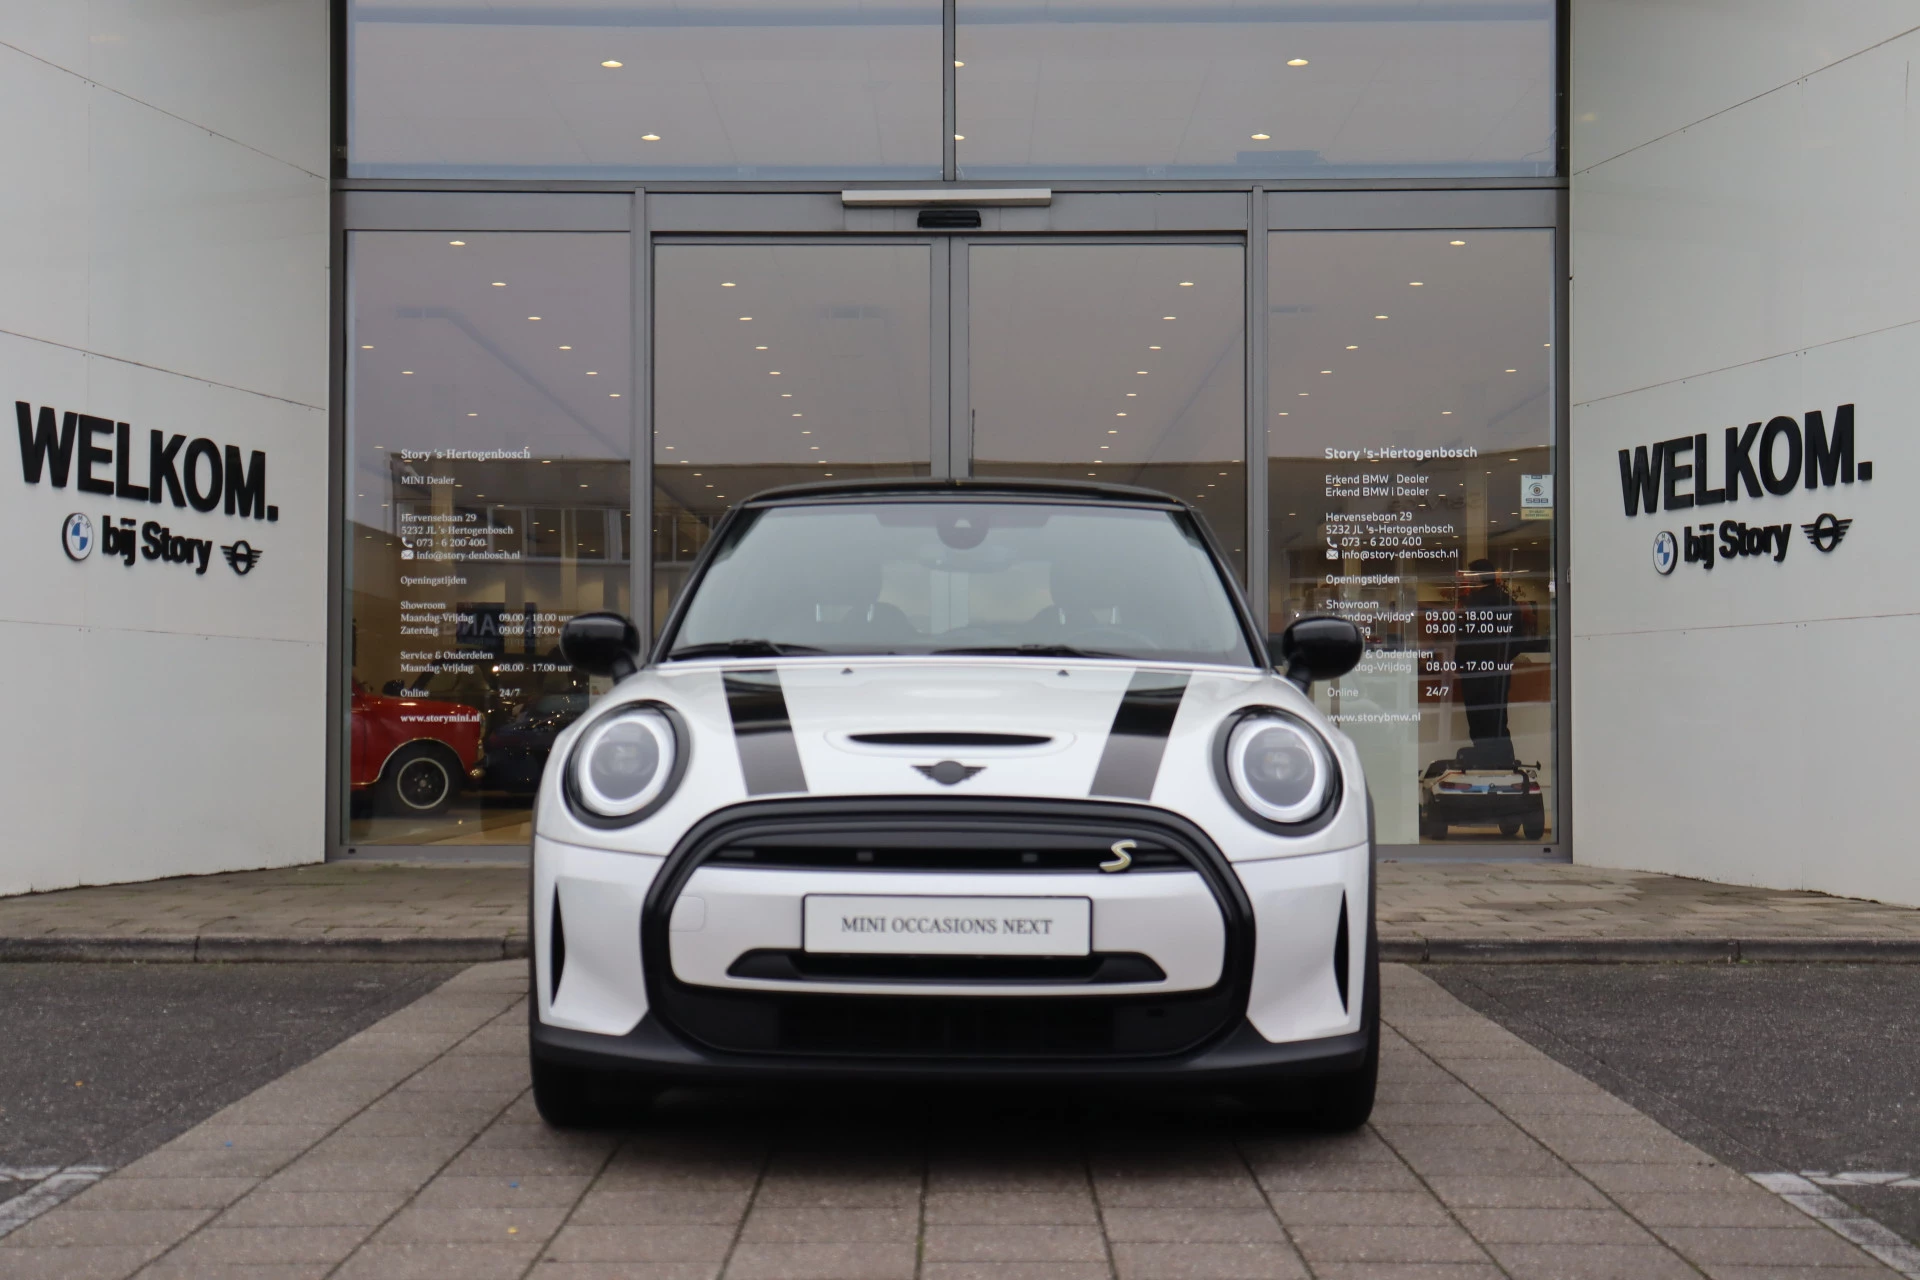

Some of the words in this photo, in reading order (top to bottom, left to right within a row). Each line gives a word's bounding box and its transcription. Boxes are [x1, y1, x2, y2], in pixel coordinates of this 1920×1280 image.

[401, 449, 431, 461] Story
[1325, 448, 1360, 461] Story
[1363, 447, 1478, 461] 's-Hertogenbosch
[15, 400, 279, 522] WELKOM.
[1618, 403, 1873, 517] WELKOM.
[401, 476, 424, 485] MINI
[427, 476, 456, 485] Dealer
[1325, 475, 1360, 484] Erkend
[1362, 475, 1389, 484] BMW
[1396, 474, 1429, 484] Dealer
[1325, 487, 1360, 497] Erkend
[1362, 487, 1389, 497] BMW
[1396, 487, 1429, 497] Dealer
[401, 513, 463, 523] Hervensebaan
[465, 513, 477, 523] 29
[1325, 512, 1397, 522] Hervensebaan
[1399, 511, 1413, 522] 29
[401, 526, 424, 535] 5232
[425, 526, 436, 536] JL
[1326, 525, 1351, 535] 5232
[1352, 525, 1364, 535] JL
[1366, 524, 1454, 537] 's-Hertogenbosch
[102, 515, 137, 567] bij
[141, 521, 212, 575] Story
[416, 538, 434, 547] 073
[441, 538, 447, 547] 6
[449, 538, 466, 547] 200
[468, 538, 486, 547] 400
[1341, 537, 1360, 547] 073
[1370, 537, 1377, 547] 6
[1378, 537, 1399, 547] 200
[1401, 537, 1422, 547] 400
[1684, 523, 1715, 570] bij
[1719, 520, 1792, 562] Story
[416, 550, 521, 561] info@story-denbosch.nl
[1341, 549, 1458, 561] info@story-denbosch.nl
[400, 575, 467, 587] Openingstijden
[1325, 574, 1400, 587] Openingstijden
[400, 601, 446, 610] Showroom
[1326, 600, 1379, 610] Showroom
[400, 613, 474, 625] Maandag-Vrijdag
[499, 613, 524, 622] 09.00
[532, 613, 556, 622] 18.00
[1327, 612, 1412, 624] andag-Vrijdag
[1425, 611, 1456, 622] 09.00
[1465, 611, 1494, 622] 18.00
[1496, 612, 1513, 621] uur
[400, 626, 439, 637] Zaterdag
[499, 626, 524, 635] 09.00
[532, 626, 556, 635] 17.00
[1425, 624, 1456, 634] 09.00
[1496, 625, 1513, 634] uur
[400, 651, 433, 660] Service
[435, 651, 441, 660] &
[443, 650, 493, 660] Onderdelen
[1365, 650, 1373, 660] &
[1375, 649, 1433, 659] Onderdelen
[400, 663, 474, 674] Maandag-Vrijdag
[499, 663, 524, 673] 08.00
[532, 663, 556, 673] 17.00
[558, 665, 573, 673] uur
[1354, 661, 1412, 674] dag-Vrijdag
[1426, 661, 1457, 671] 08.00
[1497, 662, 1514, 671] uur
[400, 689, 430, 698] Online
[499, 688, 521, 699] 24/7
[1327, 687, 1359, 697] Online
[1426, 686, 1449, 697] 24/7
[400, 713, 481, 725] www.storymini.nl
[1327, 712, 1421, 723] www.storybmw.nl
[1099, 839, 1137, 872] S
[841, 916, 887, 933] MINI
[891, 917, 998, 934] OCCASIONS
[1002, 918, 1053, 935] NEXT
